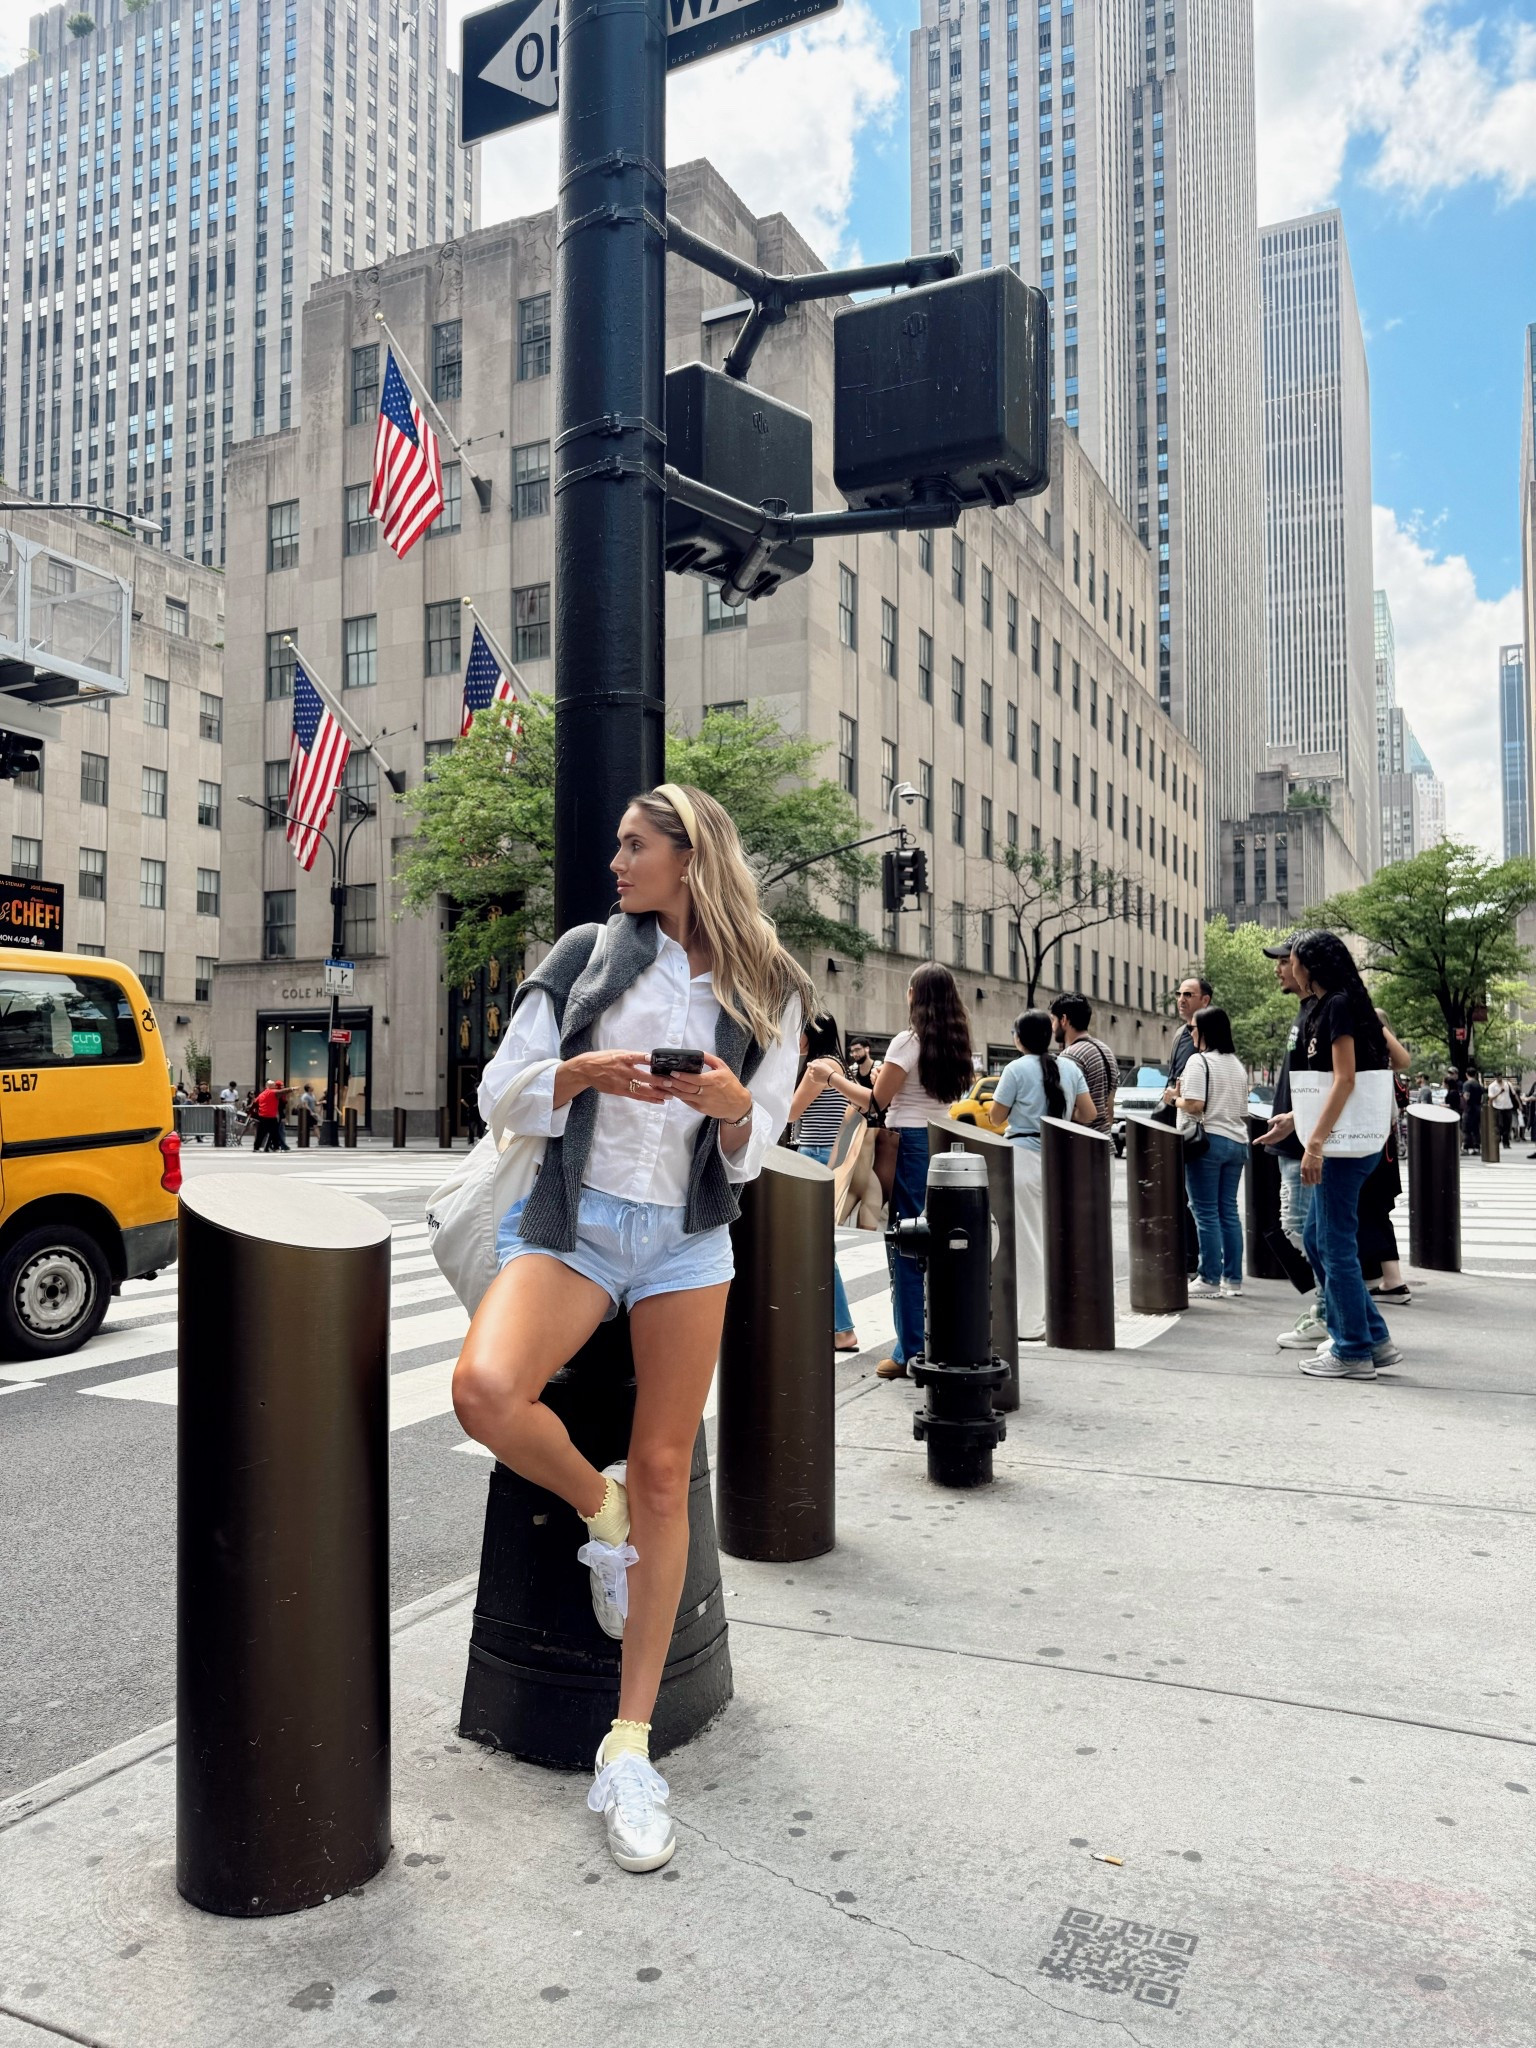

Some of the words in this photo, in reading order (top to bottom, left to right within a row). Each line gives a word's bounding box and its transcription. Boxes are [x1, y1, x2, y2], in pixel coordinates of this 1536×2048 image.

[671, 50, 696, 64] DEPT
[706, 41, 719, 51] OF
[730, 3, 820, 42] TRANSPORTATION
[11, 900, 60, 930] CHEF!
[282, 988, 312, 999] COLE
[72, 1033, 101, 1044] curb
